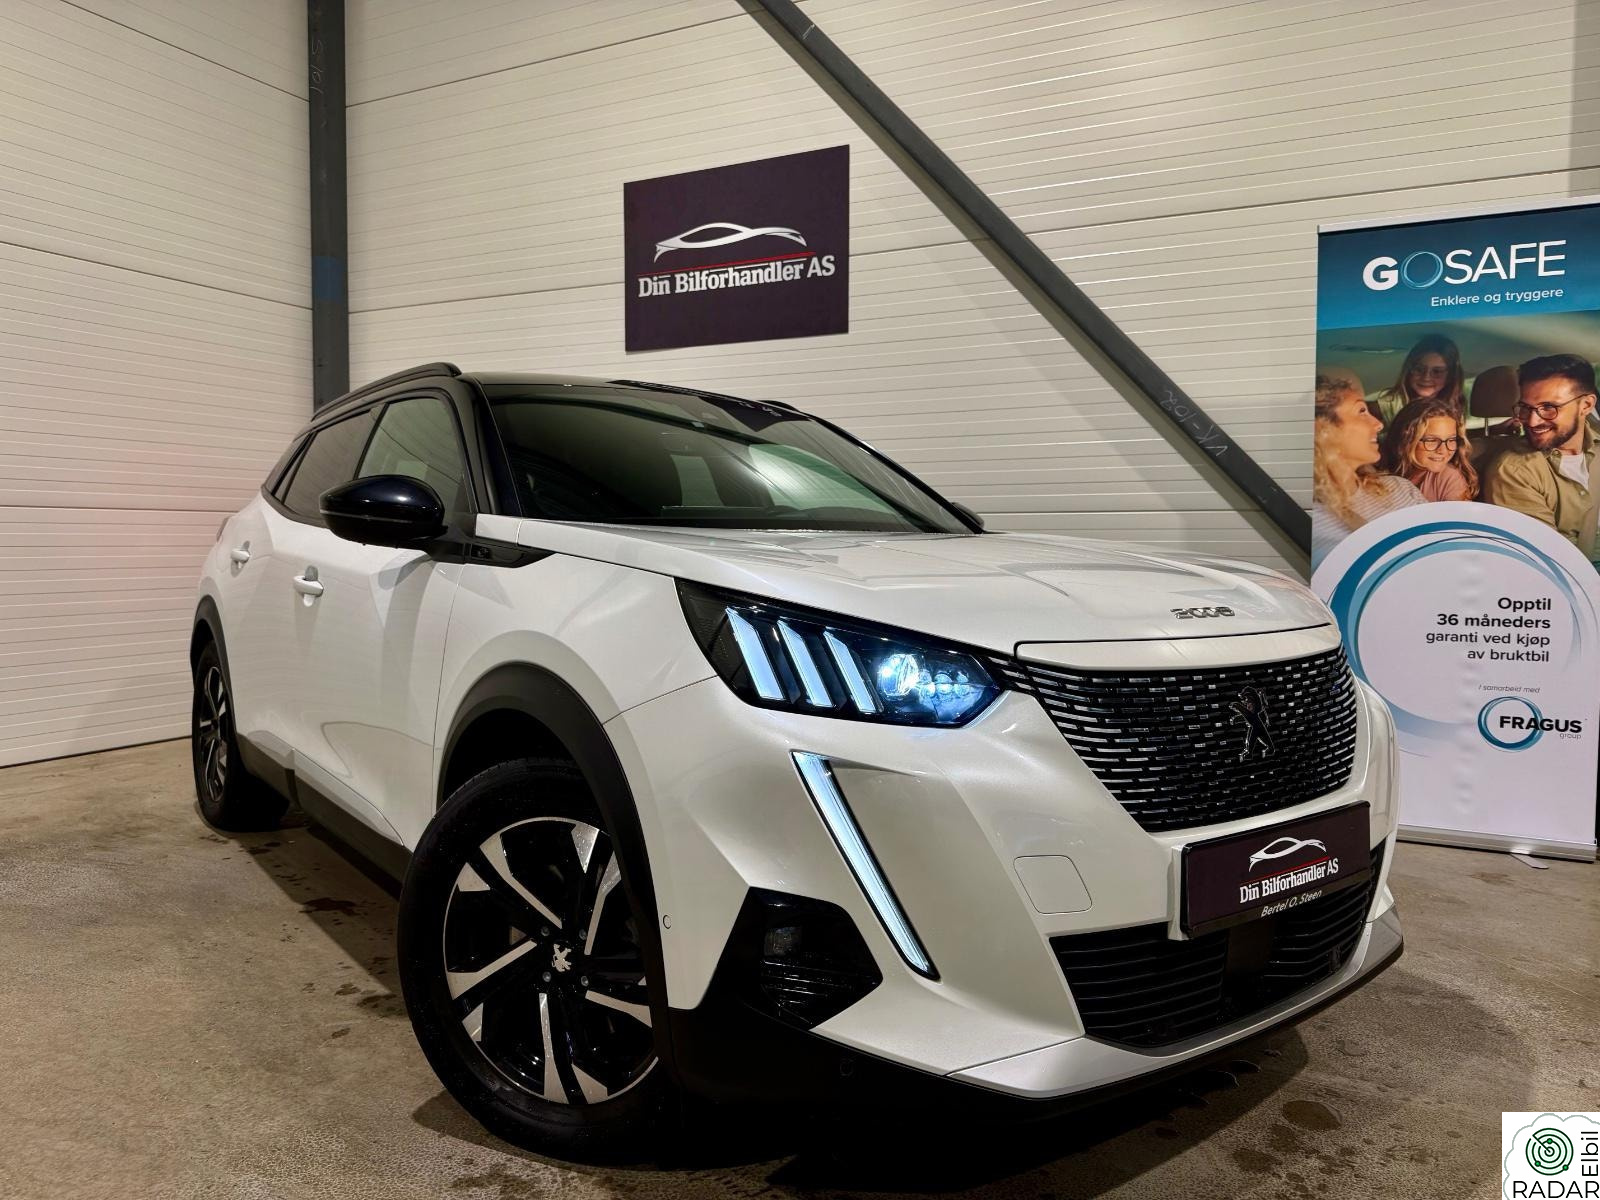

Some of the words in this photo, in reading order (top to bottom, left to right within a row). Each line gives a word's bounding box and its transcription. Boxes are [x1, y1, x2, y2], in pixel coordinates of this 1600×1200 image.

[1363, 240, 1566, 290] GOSAFE
[638, 276, 671, 297] Din
[674, 260, 804, 293] Bilforhandler
[806, 255, 835, 278] AS
[1431, 295, 1480, 307] Enklere
[1484, 293, 1501, 305] og
[1505, 288, 1564, 303] tryggere
[1497, 597, 1551, 613] Opptil
[1437, 613, 1459, 626] 36
[1464, 614, 1551, 628] måneders
[1426, 632, 1478, 644] garanti
[1483, 633, 1511, 644] ved
[1516, 633, 1550, 648] kjøp
[1467, 650, 1485, 660] av
[1490, 649, 1549, 662] bruktbil
[1499, 715, 1582, 733] FRAGUS
[1240, 883, 1260, 904] Din
[1261, 863, 1326, 897] Bilforhandler
[1326, 857, 1339, 876] AS
[1261, 899, 1288, 917] Bertel
[1289, 896, 1298, 908] O.
[1299, 890, 1322, 904] Steen
